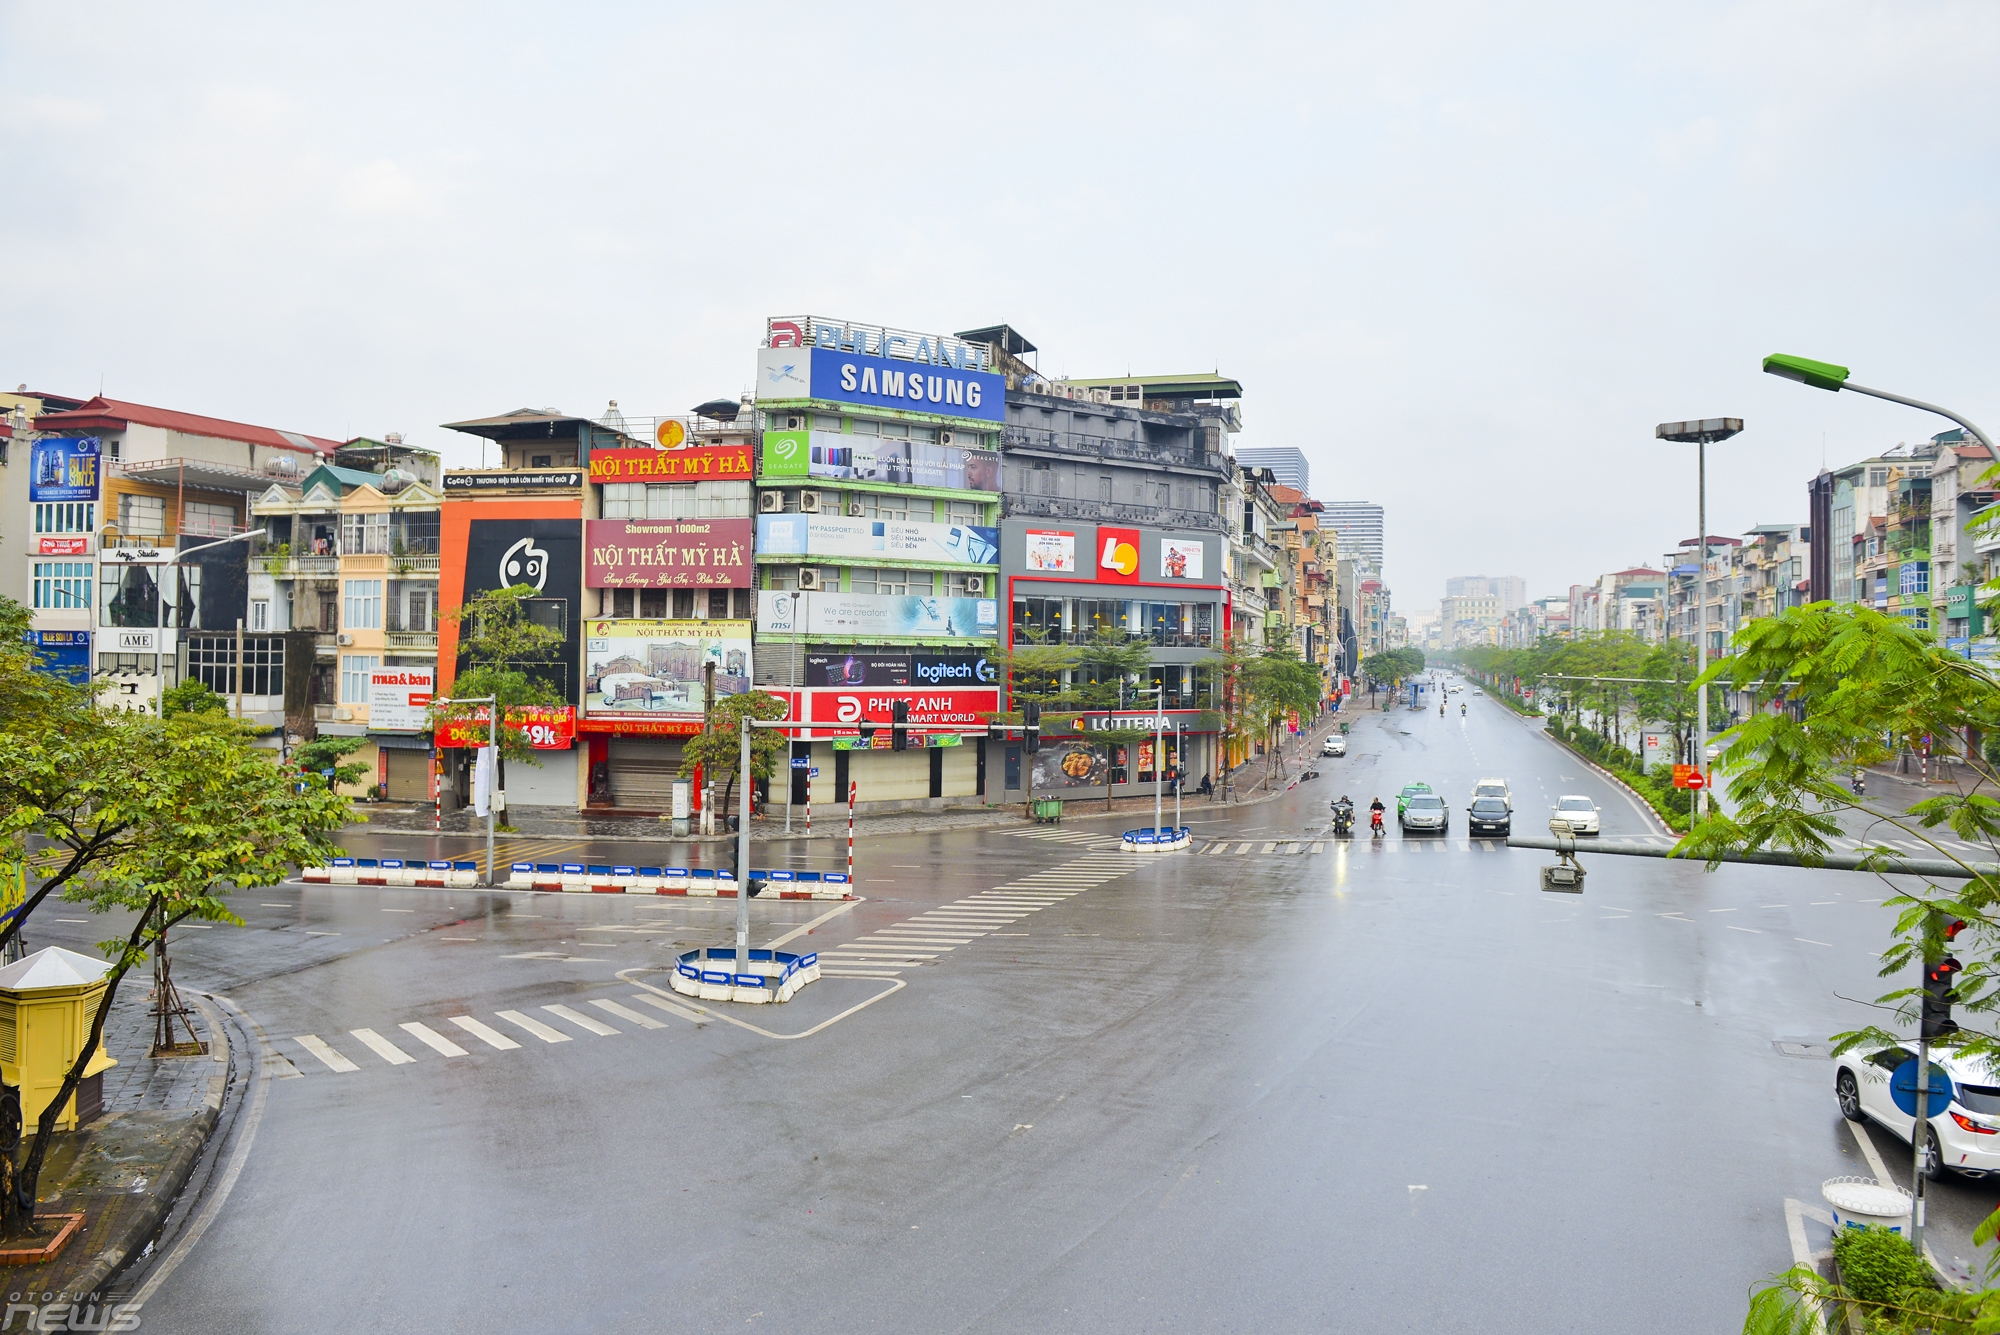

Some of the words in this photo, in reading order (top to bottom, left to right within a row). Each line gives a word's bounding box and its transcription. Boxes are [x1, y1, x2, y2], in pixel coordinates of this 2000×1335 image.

[912, 336, 983, 373] ANH
[840, 363, 982, 408] SAMSUNG
[69, 457, 96, 474] BLUE
[589, 455, 621, 481] NỘI
[624, 449, 680, 475] THẤT
[683, 452, 714, 474] MỸ
[718, 449, 751, 473] HÀ
[878, 455, 896, 463] LUÔN
[925, 459, 936, 467] VỚI
[916, 468, 943, 476] SEAGATE
[85, 472, 94, 486] LA
[625, 525, 672, 534] Showroom
[675, 524, 710, 534] 1000m2
[773, 524, 790, 533] WD
[137, 550, 159, 558] Studio
[593, 544, 623, 570] NỘI
[627, 539, 677, 566] THẤT
[681, 542, 709, 566] MỸ
[712, 540, 743, 566] HÀ
[603, 572, 624, 587] Sang
[625, 573, 649, 587] Trọng
[657, 573, 672, 585] Giá
[674, 573, 688, 585] Trị
[696, 572, 713, 584] Bền
[715, 573, 731, 584] Lâu
[1948, 594, 1967, 604] oppo
[824, 607, 837, 615] We
[43, 633, 55, 642] BLUE
[67, 633, 73, 641] LA
[636, 629, 654, 637] NỘI
[657, 627, 685, 637] THẤT
[687, 627, 702, 637] MỸ
[705, 627, 722, 637] HÀ
[124, 635, 149, 645] AME
[918, 662, 972, 683] logitech
[372, 675, 398, 684] mua
[399, 673, 407, 685] &
[409, 673, 430, 685] bán
[915, 698, 952, 711] ANH
[906, 713, 938, 724] SMART
[940, 713, 975, 722] WORLD
[1092, 716, 1172, 731] LOTTERIA
[614, 723, 633, 733] NỘI
[635, 722, 664, 732] THẤT
[666, 724, 684, 733] MỸ
[685, 723, 701, 733] HÀ
